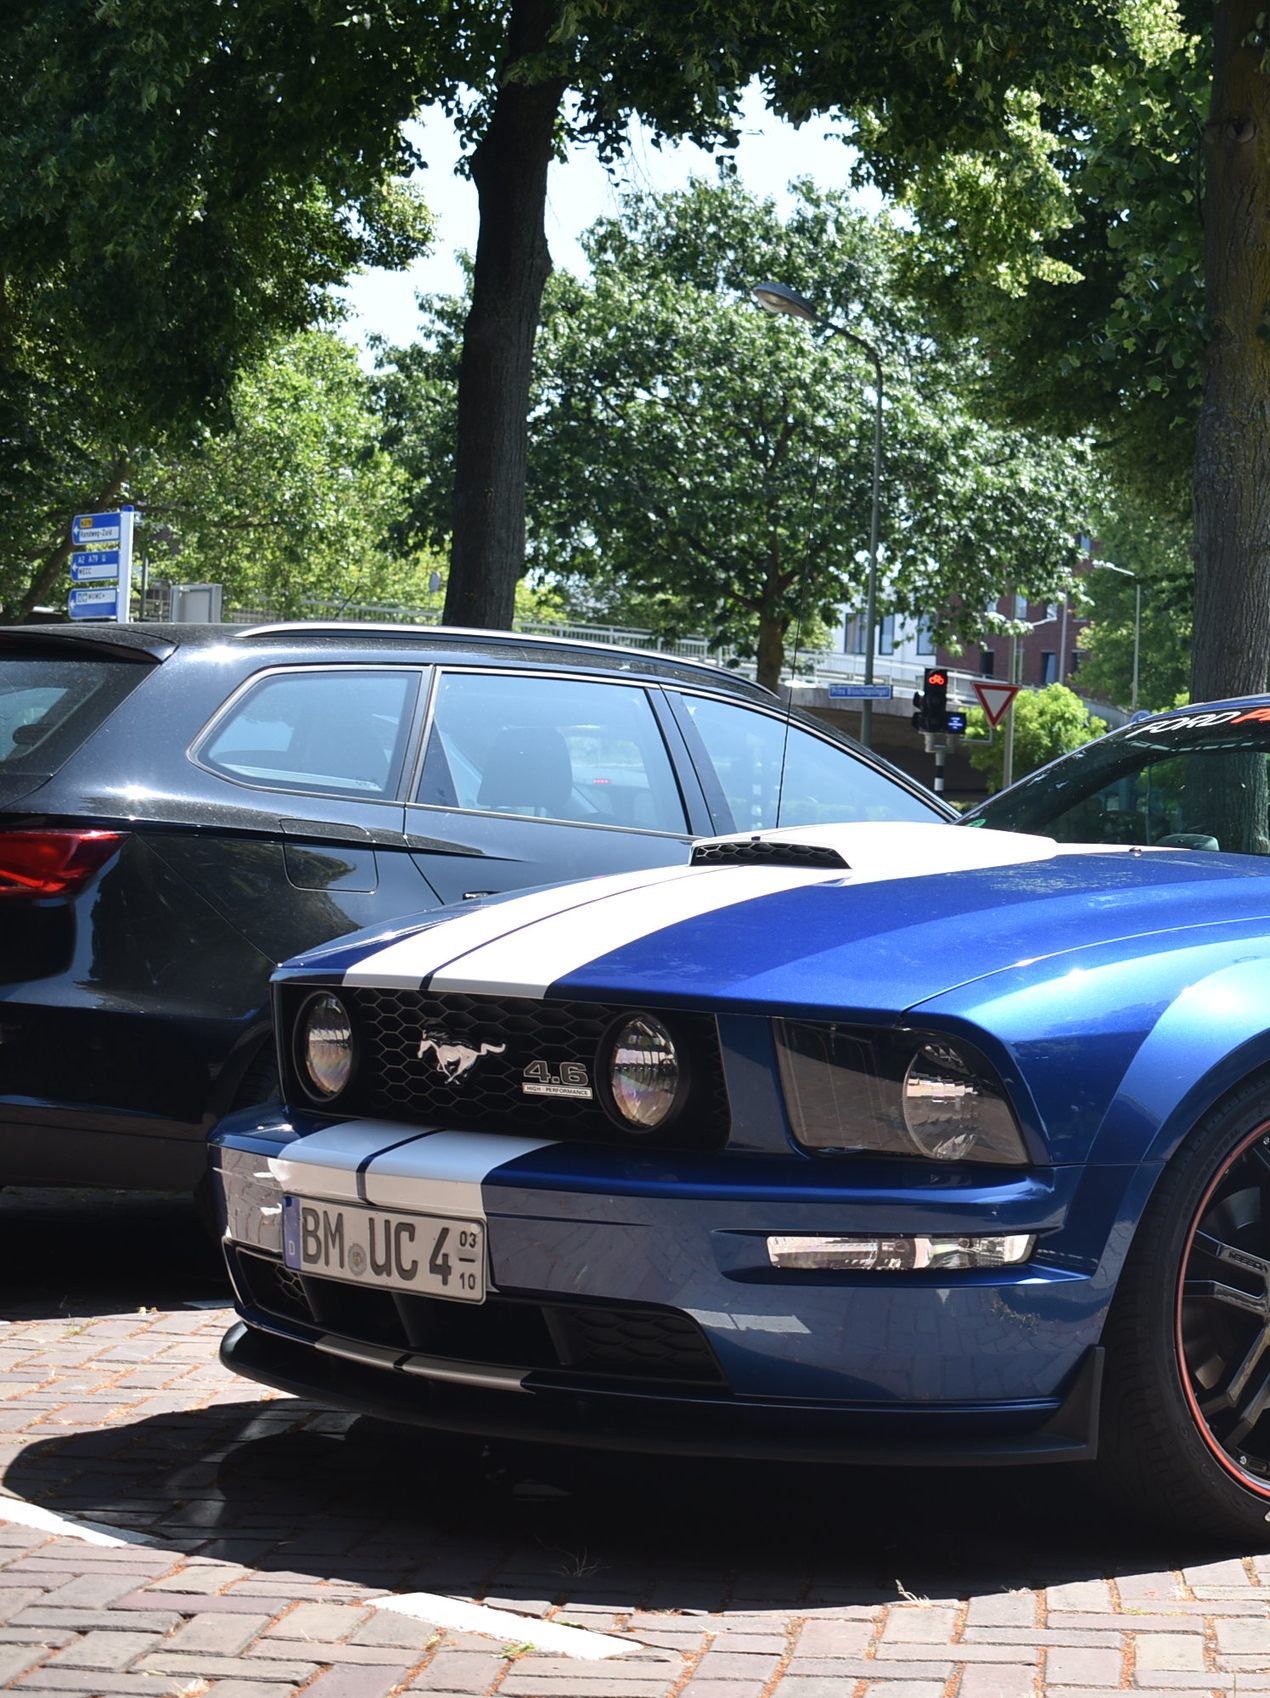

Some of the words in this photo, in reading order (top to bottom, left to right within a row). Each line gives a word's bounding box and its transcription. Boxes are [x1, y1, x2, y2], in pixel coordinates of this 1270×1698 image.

[78, 556, 85, 564] A2
[88, 555, 99, 563] A79
[1125, 711, 1241, 738] FORD
[523, 1060, 589, 1086] 4.6
[288, 1239, 296, 1256] D
[302, 1207, 345, 1270] BM
[369, 1217, 418, 1281] UC
[429, 1227, 452, 1286] 4
[459, 1231, 477, 1248] 03
[459, 1272, 476, 1290] 10
